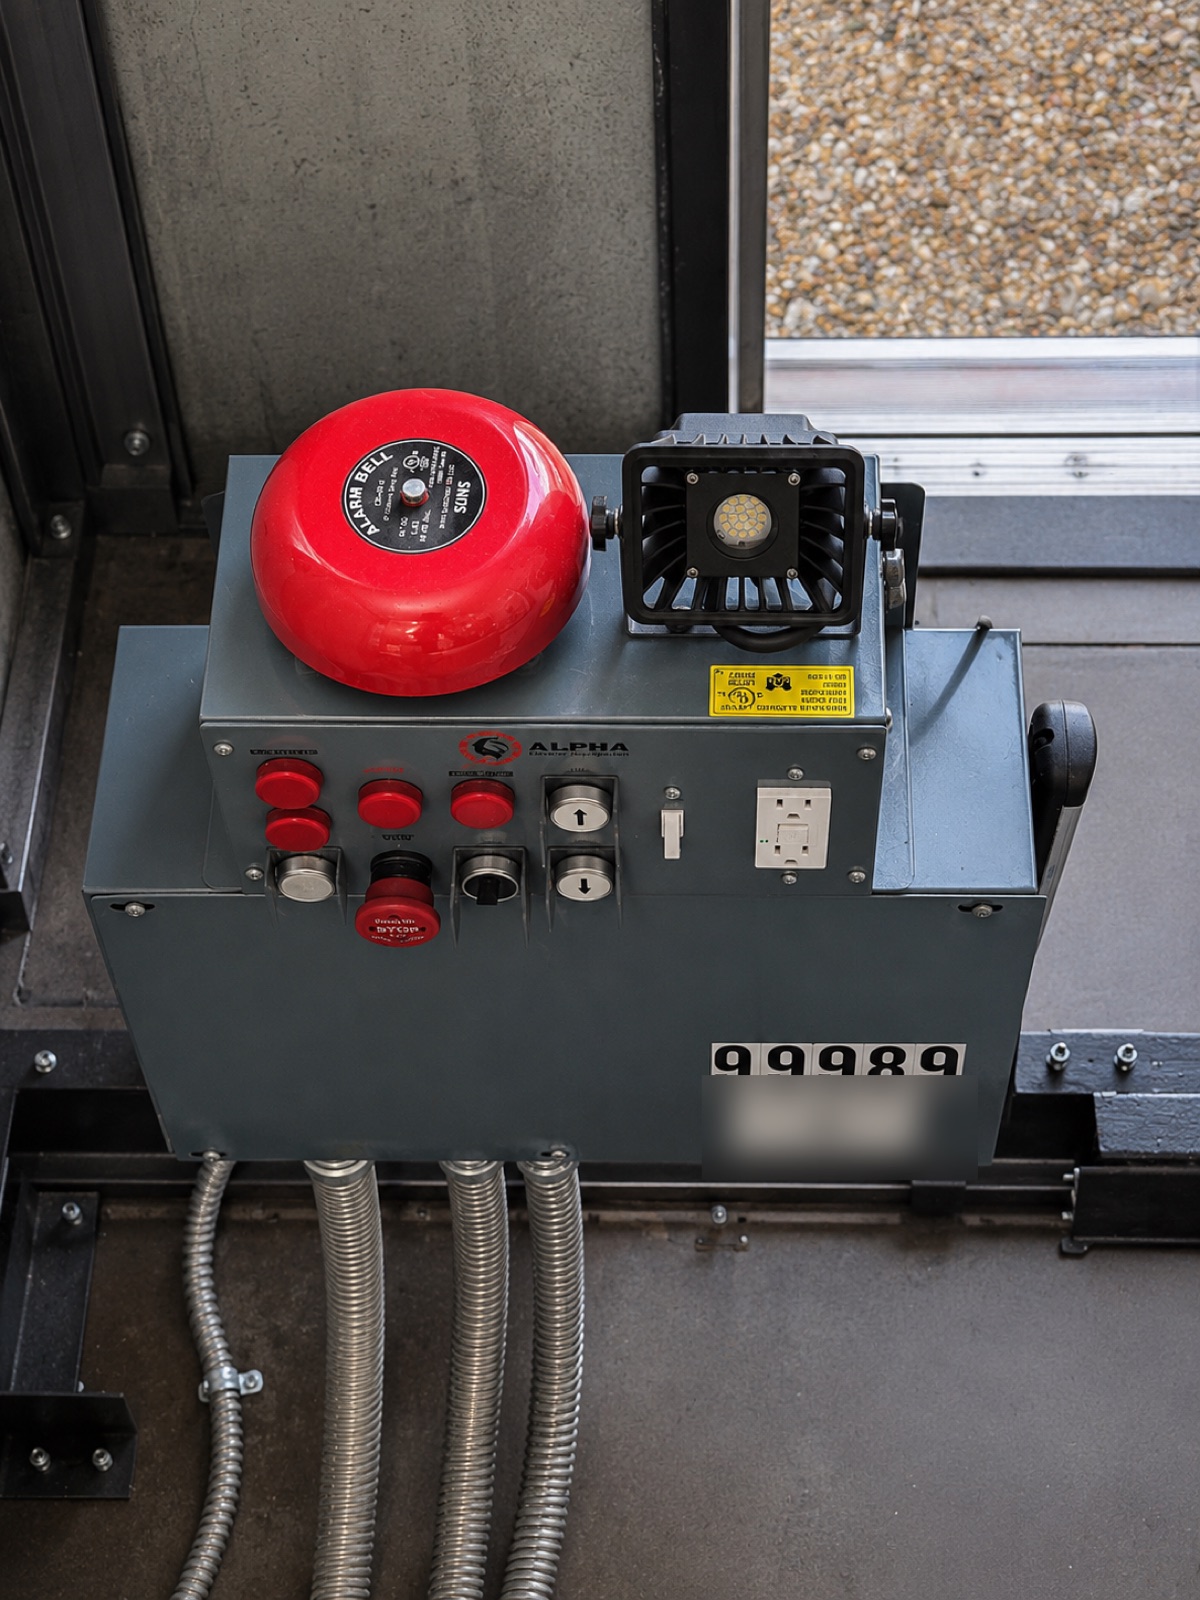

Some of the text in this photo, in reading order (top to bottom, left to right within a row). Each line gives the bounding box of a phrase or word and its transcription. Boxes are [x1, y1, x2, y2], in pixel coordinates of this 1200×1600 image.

[355, 452, 394, 483] BELL
[350, 487, 380, 536] ALARM
[454, 481, 472, 514] SUNS
[529, 742, 629, 751] ALPHA
